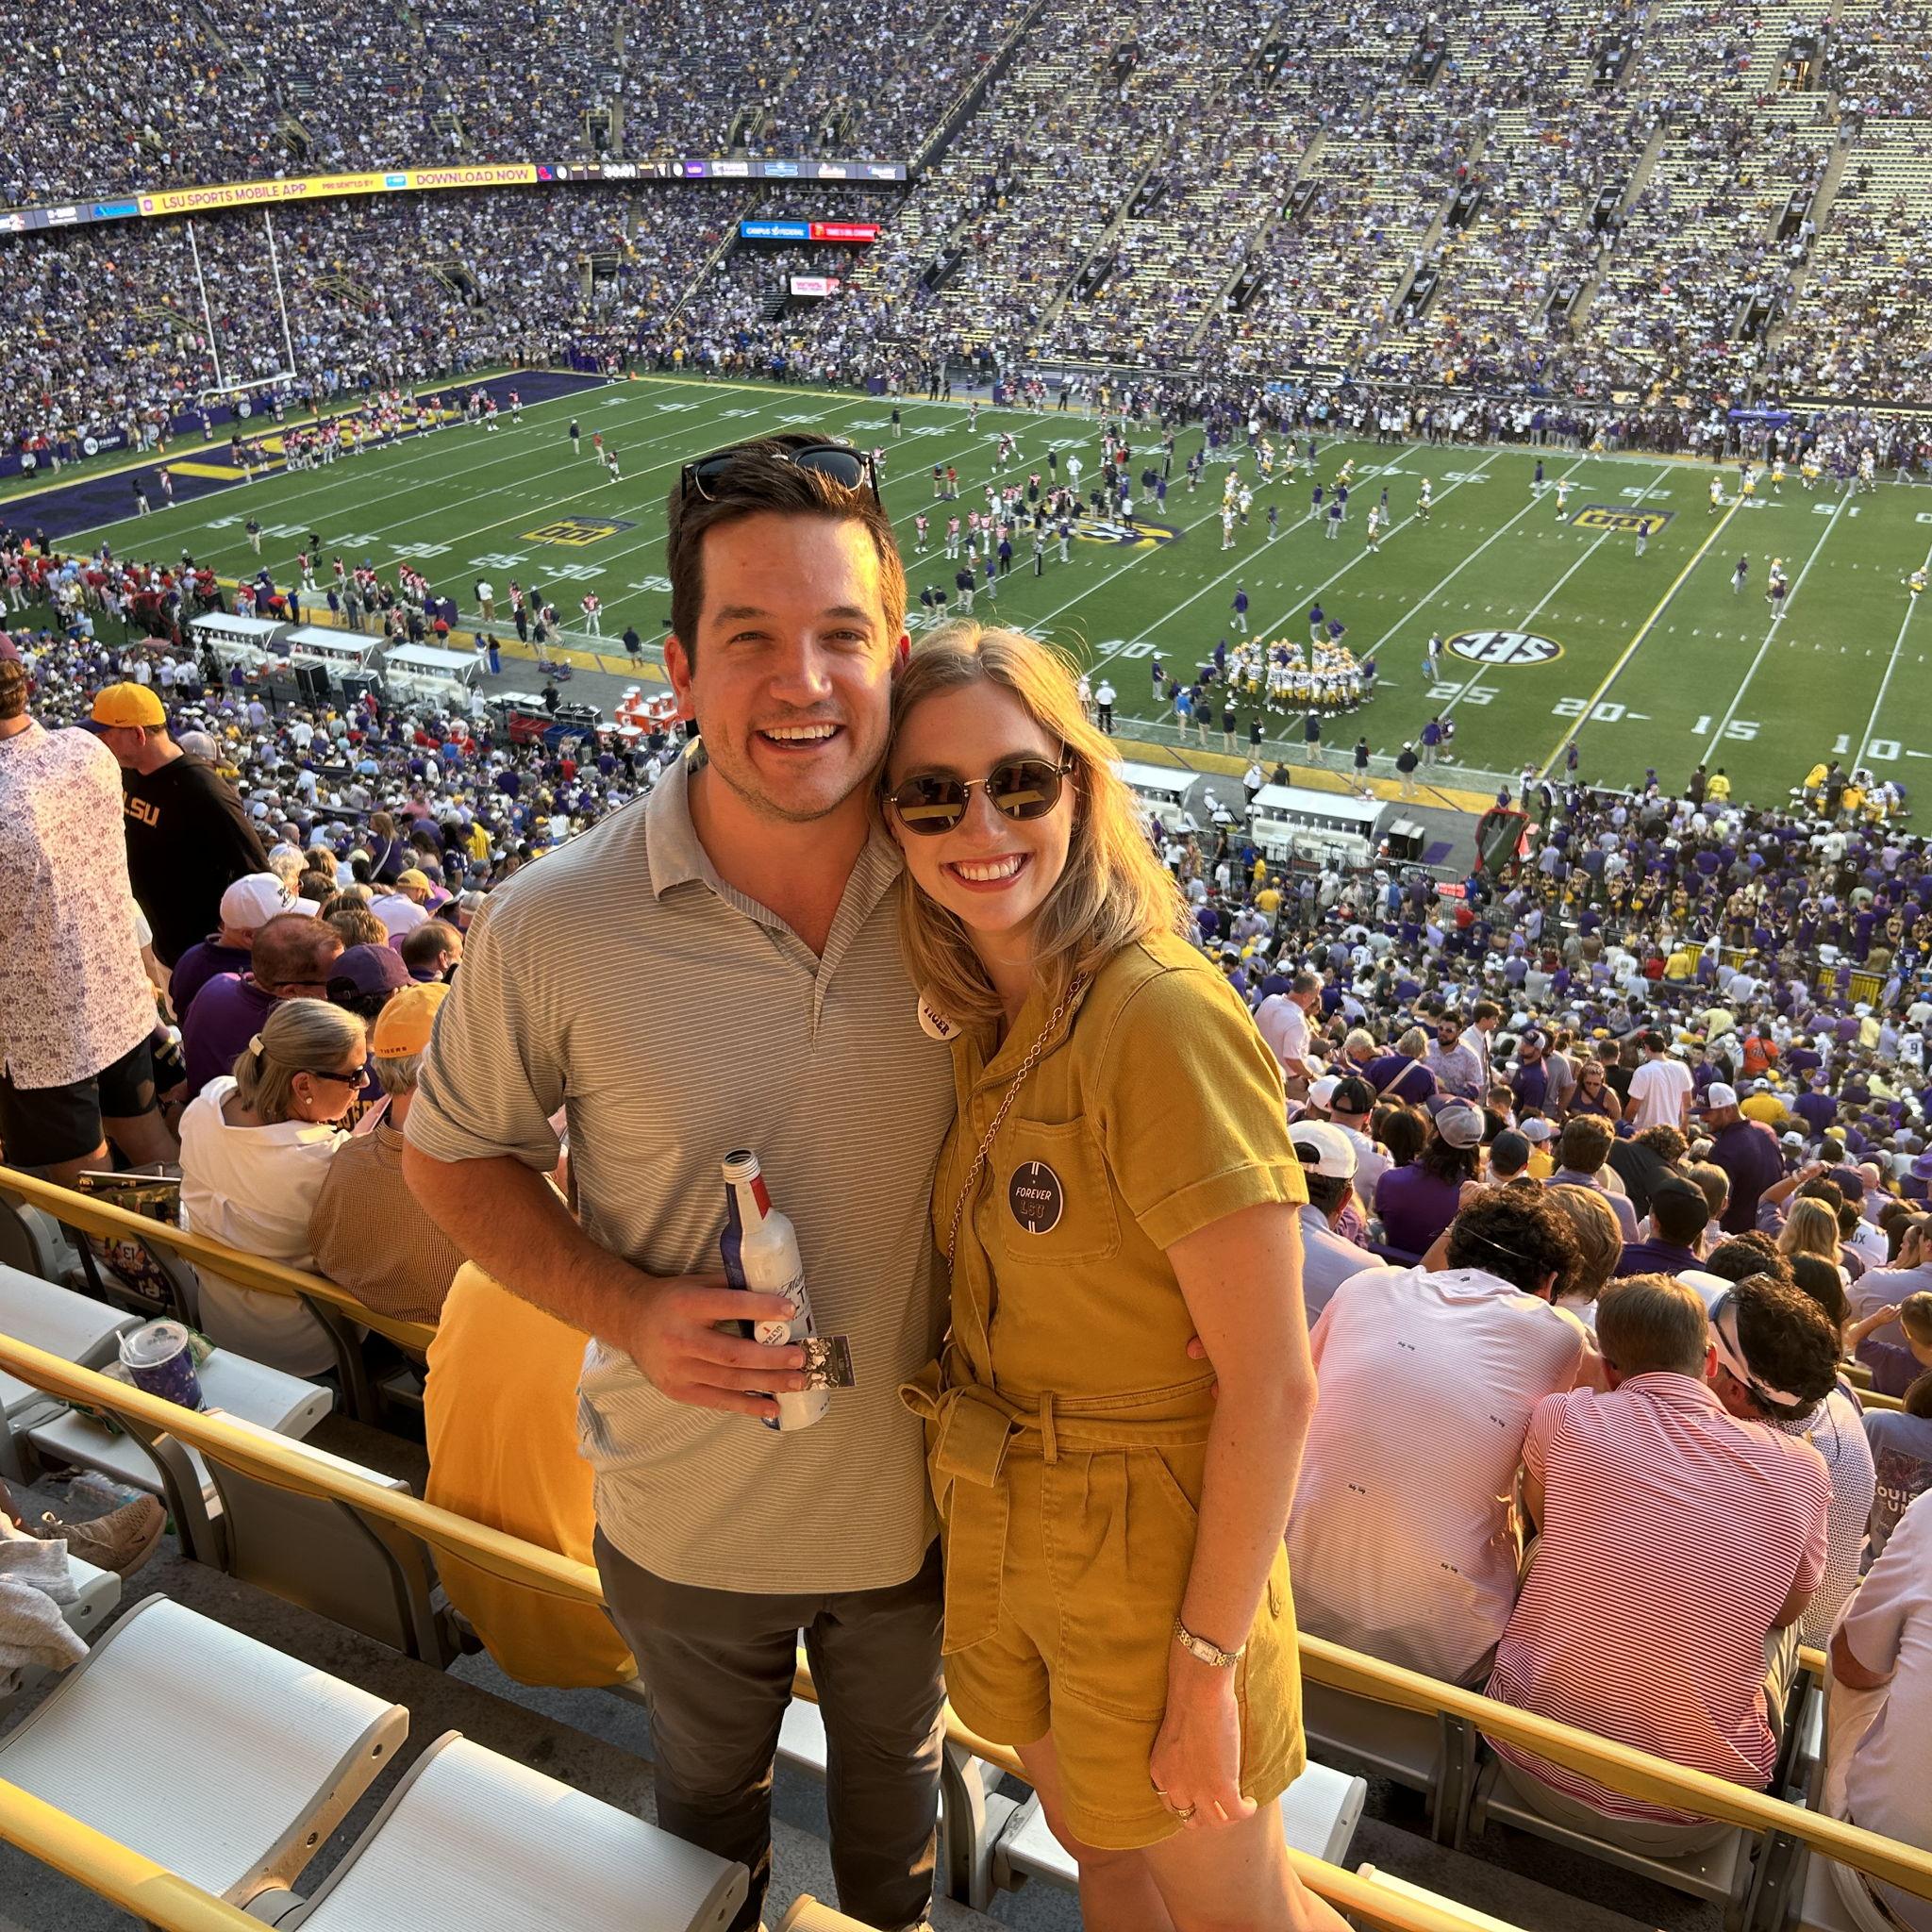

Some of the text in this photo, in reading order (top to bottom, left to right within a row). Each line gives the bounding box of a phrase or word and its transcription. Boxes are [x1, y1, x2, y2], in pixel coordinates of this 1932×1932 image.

[416, 171, 493, 186] DOWNLOAD
[496, 169, 529, 181] NOW
[161, 183, 307, 209] LSU SPORTS MOBILE APP
[325, 533, 381, 548] 15
[394, 542, 453, 558] 20
[468, 553, 529, 570] 25
[546, 564, 608, 581] 30
[1095, 640, 1158, 658] 40
[1425, 680, 1500, 706] 25
[1551, 696, 1625, 723] 20
[1690, 715, 1761, 741] 15
[1830, 733, 1903, 761] 10
[380, 1046, 408, 1055] TIGERS
[1910, 1041, 1918, 1055] 9
[1015, 1187, 1052, 1201] FOREVER
[1021, 1200, 1045, 1219] LSU
